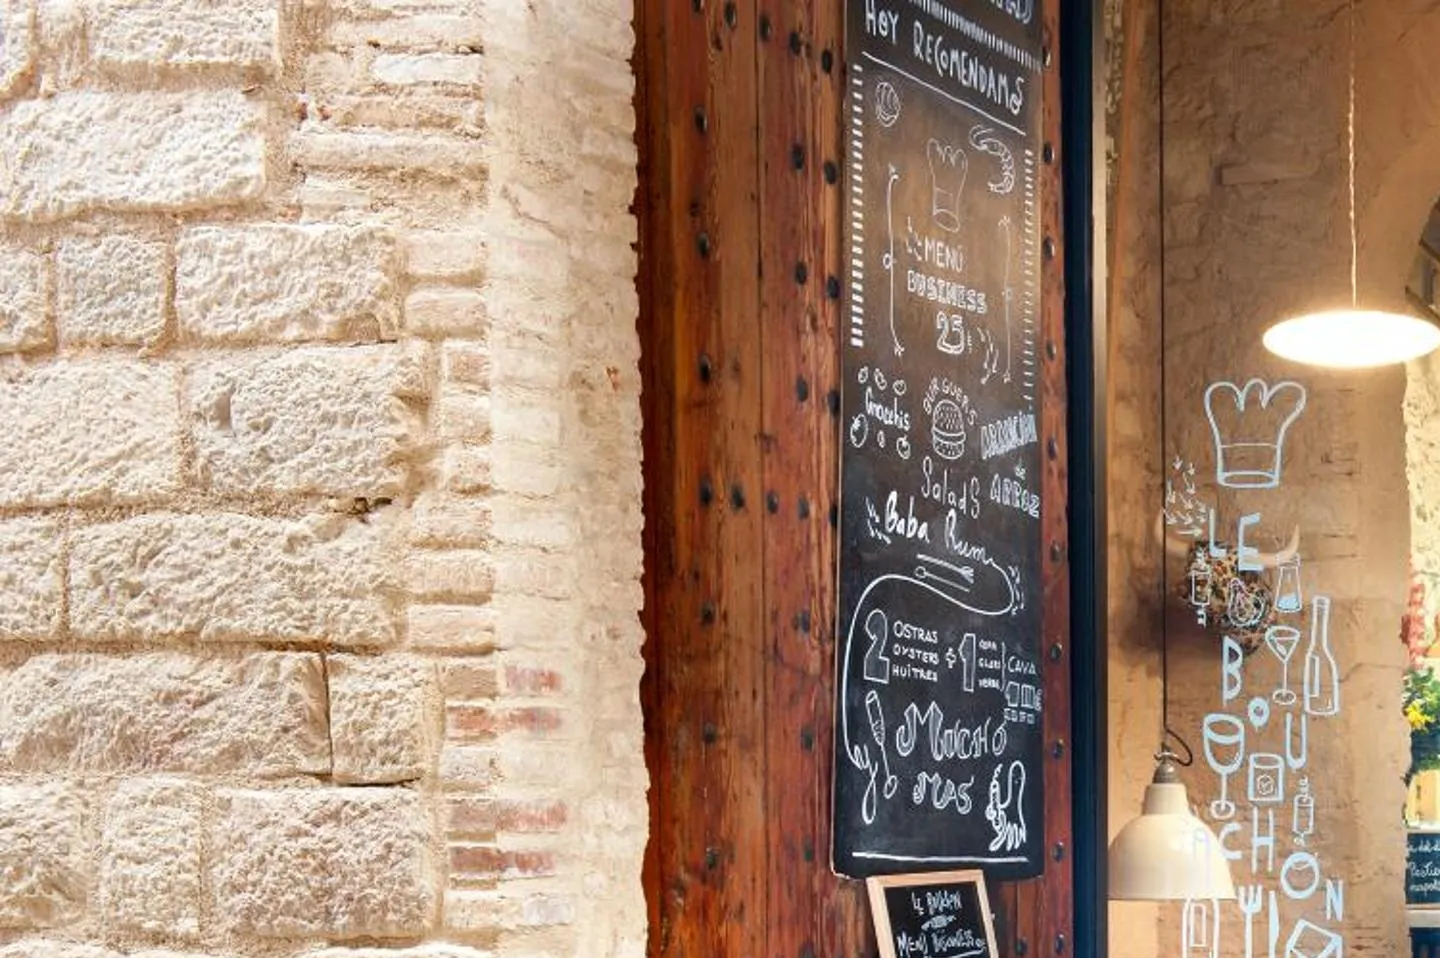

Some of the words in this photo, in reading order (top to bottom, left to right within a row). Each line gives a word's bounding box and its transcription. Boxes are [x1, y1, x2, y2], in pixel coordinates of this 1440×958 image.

[865, 0, 899, 44] HOY
[1208, 508, 1263, 571] LE
[893, 620, 938, 644] OSTRAS
[893, 643, 940, 665] OYSTERS
